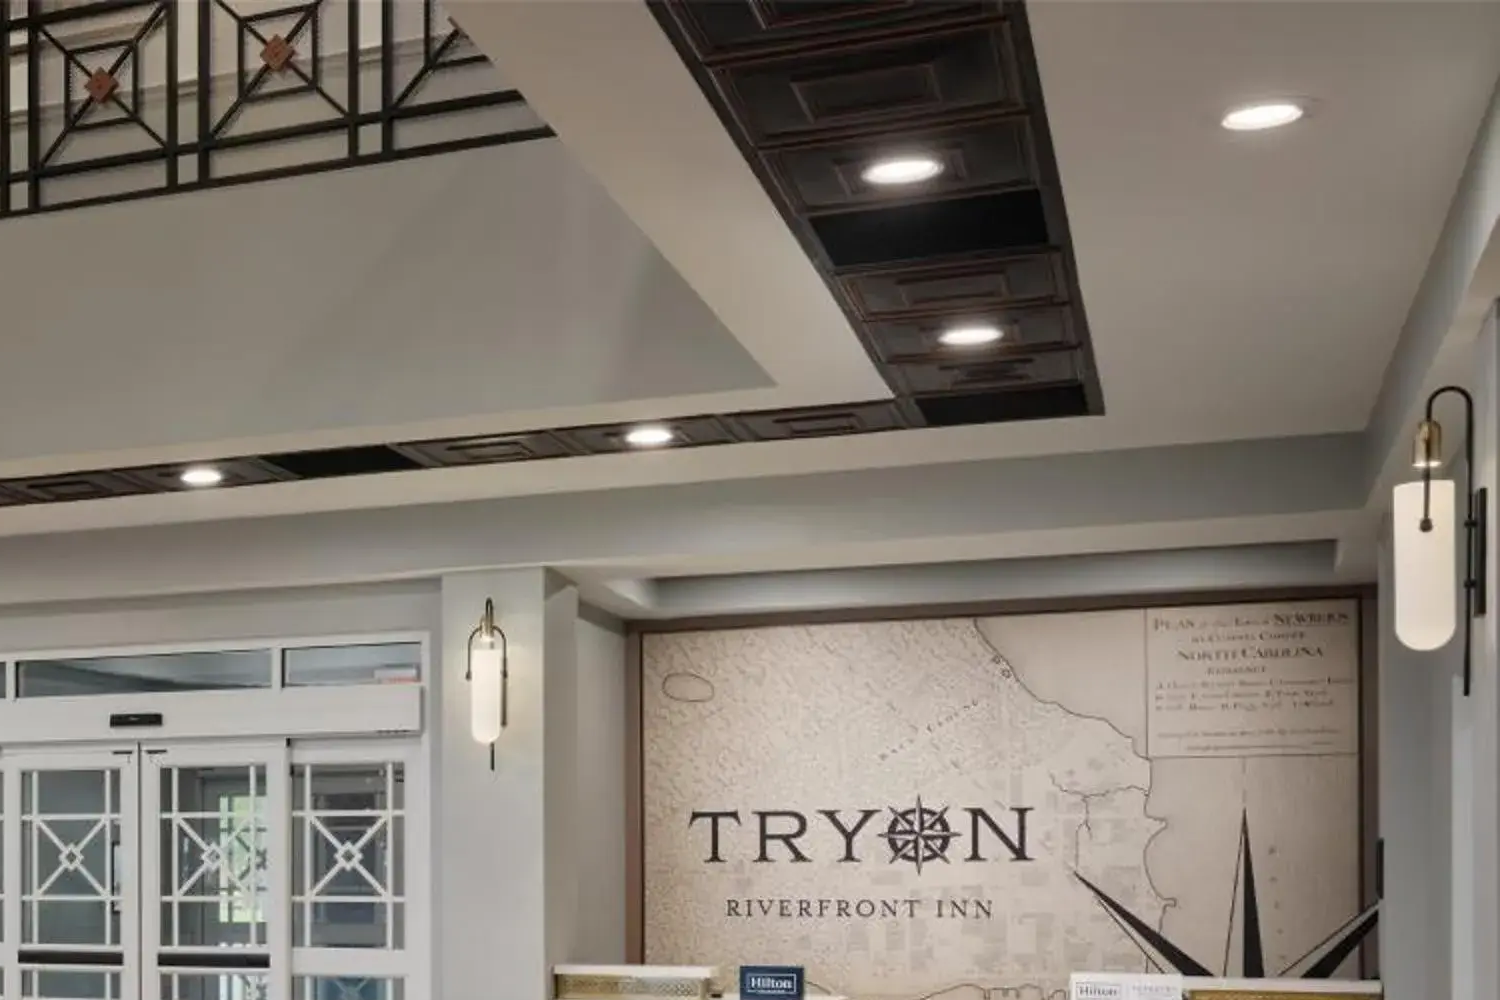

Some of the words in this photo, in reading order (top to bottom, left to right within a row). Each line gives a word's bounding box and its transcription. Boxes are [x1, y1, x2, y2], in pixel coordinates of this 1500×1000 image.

[688, 797, 1035, 873] TRYON
[725, 899, 921, 918] RIVERFRONT
[936, 899, 993, 918] INN
[750, 976, 792, 989] Hilton
[1078, 985, 1117, 996] Hilton
